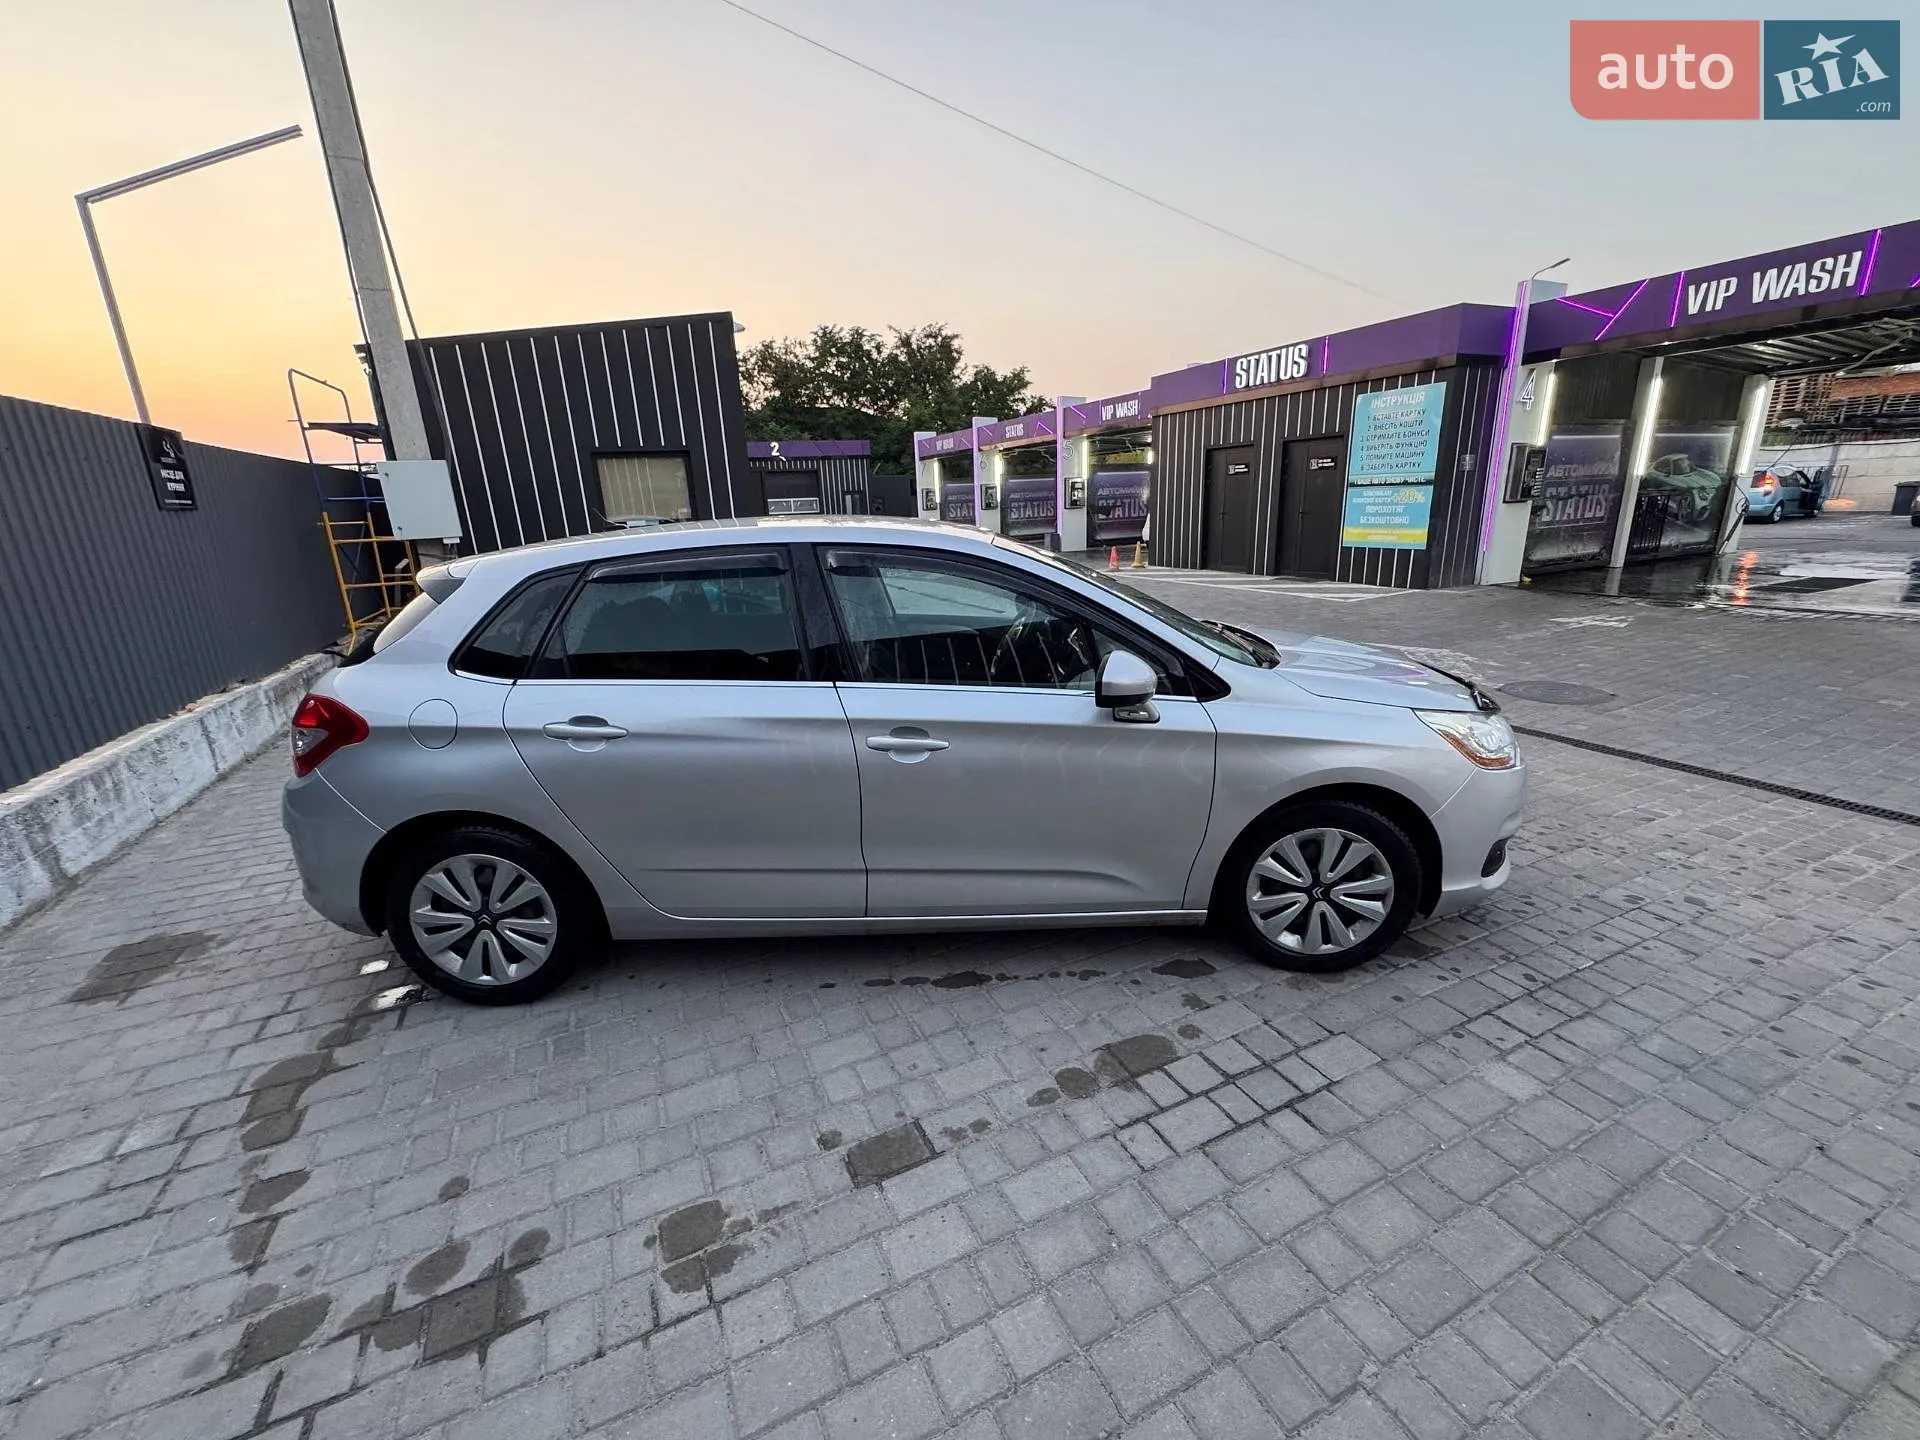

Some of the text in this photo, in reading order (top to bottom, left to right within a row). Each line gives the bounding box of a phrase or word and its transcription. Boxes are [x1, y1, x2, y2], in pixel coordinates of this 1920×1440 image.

[1688, 251, 1863, 315] VIP WASH
[1235, 343, 1309, 389] STATUS
[1521, 368, 1536, 410] 4
[1371, 391, 1426, 409] ІНСТРУКЦІЯ
[1101, 400, 1138, 421] VIP WASH
[1005, 423, 1024, 439] STATUS
[770, 441, 780, 456] 2
[1062, 439, 1074, 460] 5
[949, 502, 974, 519] STAT
[1010, 500, 1055, 519] STATUS
